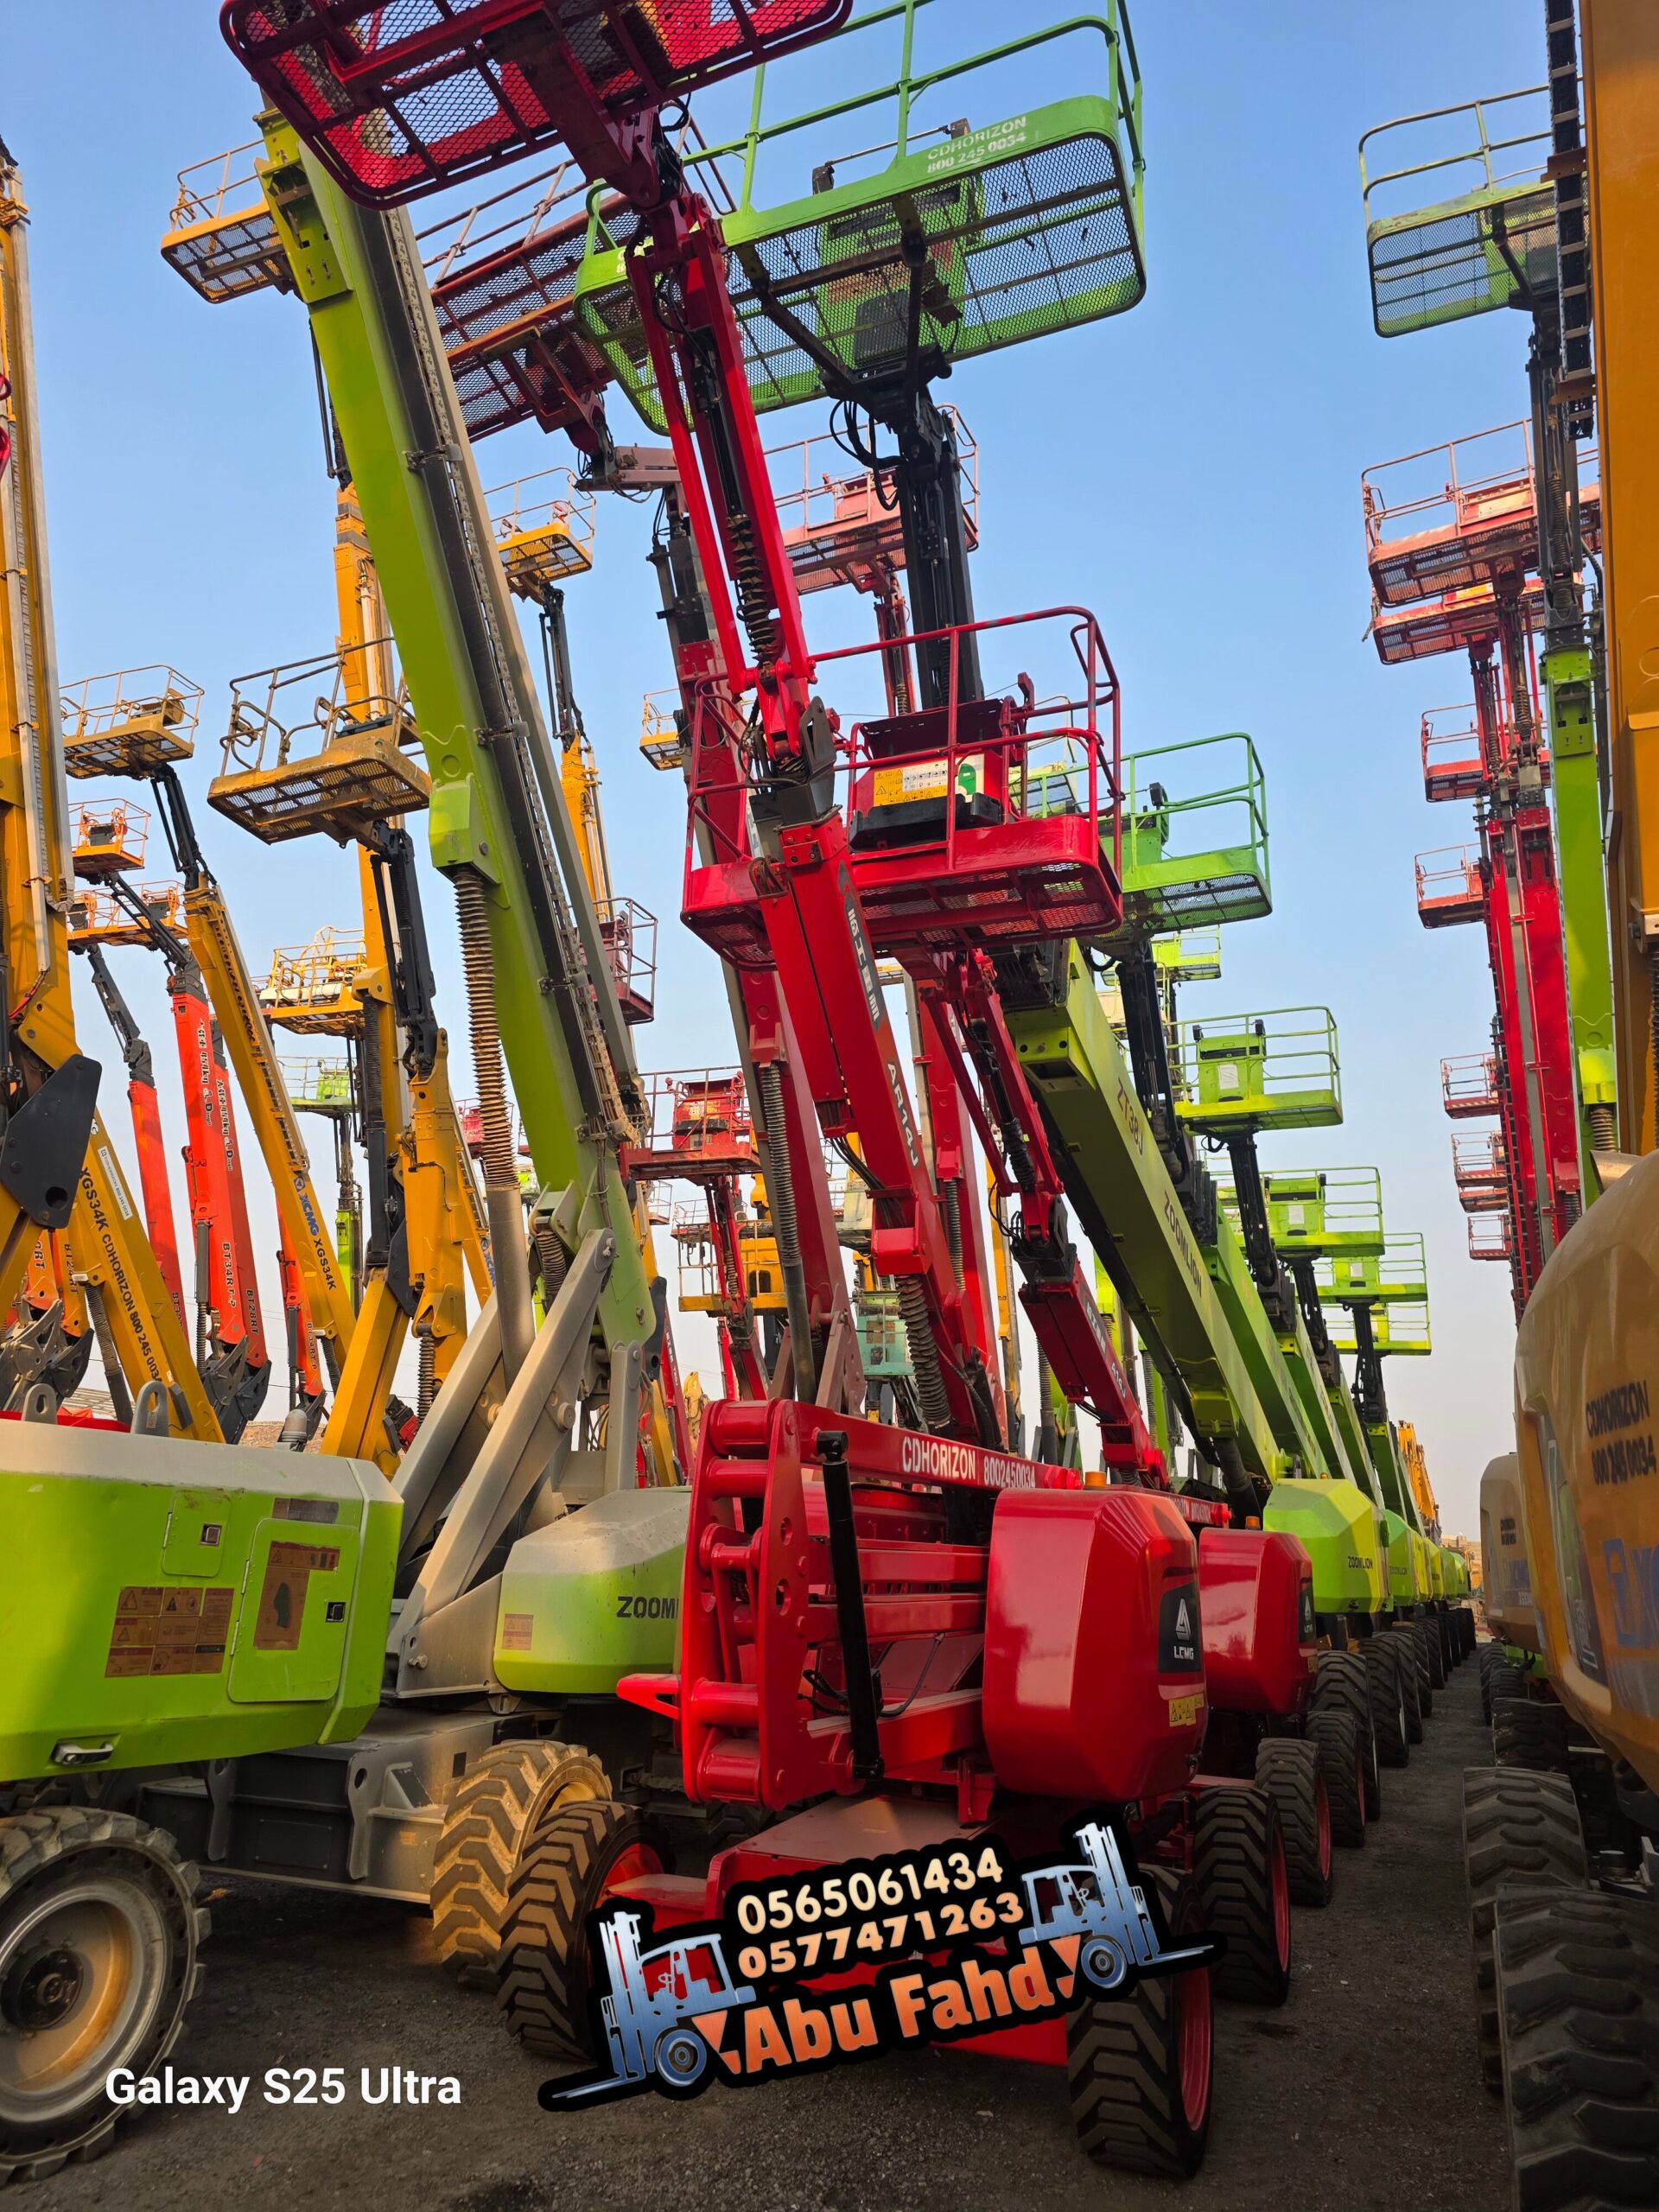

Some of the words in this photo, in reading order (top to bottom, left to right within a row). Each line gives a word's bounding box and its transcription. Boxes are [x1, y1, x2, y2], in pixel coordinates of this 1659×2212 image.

[927, 116, 1027, 160] CDHORIZON
[887, 1062, 919, 1166] AR14J
[1117, 1077, 1143, 1155] ZT38J
[79, 1166, 110, 1231] XGS34K
[102, 1233, 136, 1311] CDHORIZON
[130, 1307, 144, 1334] 800
[139, 1333, 152, 1356] 245
[299, 1191, 320, 1236] XCMG
[313, 1238, 336, 1291] XGS34K
[1163, 1189, 1202, 1298] ZOOMLION
[246, 1288, 258, 1334] BT28RT
[902, 1436, 976, 1480] CDHORIZON
[983, 1456, 1035, 1489] 8002450034
[1348, 1556, 1373, 1569] ZOOMLION
